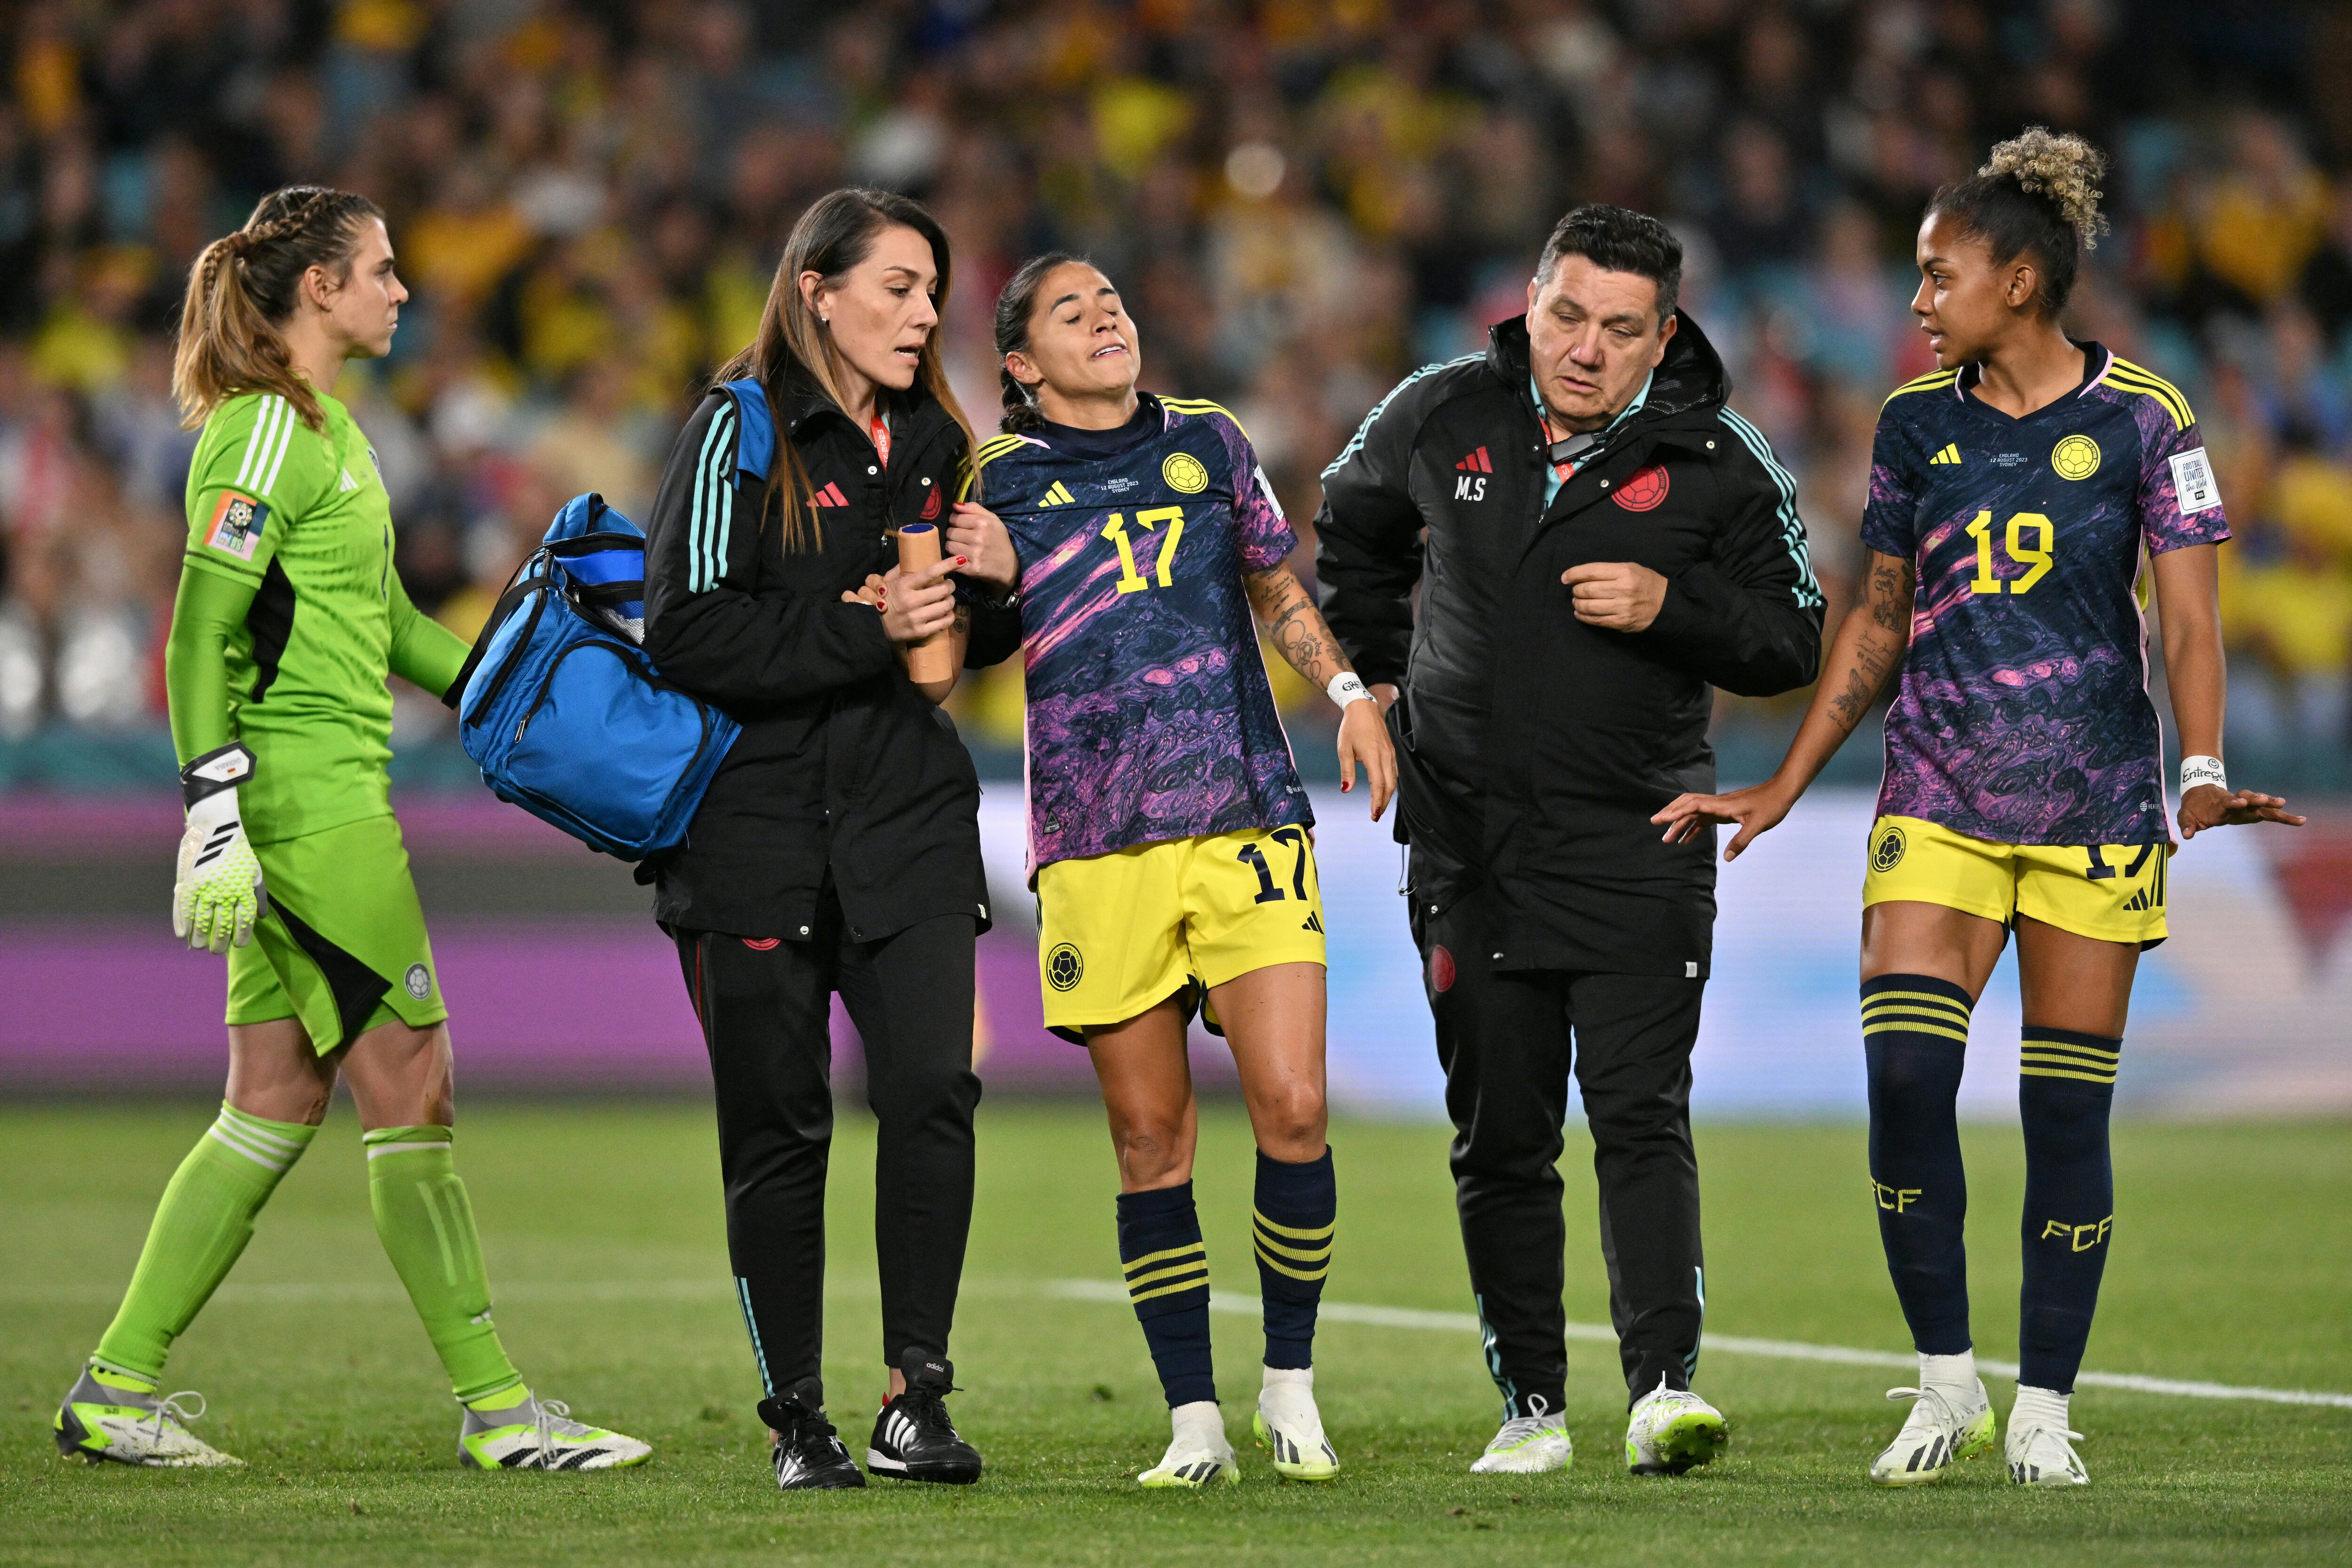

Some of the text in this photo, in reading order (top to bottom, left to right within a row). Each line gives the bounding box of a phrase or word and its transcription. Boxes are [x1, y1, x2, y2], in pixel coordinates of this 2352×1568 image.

[2183, 459, 2201, 471] FOOTBALL
[2184, 467, 2204, 482] UNITES
[1455, 476, 1486, 501] M.S
[2185, 482, 2195, 492] the
[1101, 506, 1184, 594] 17
[1965, 510, 2053, 594] 19
[2183, 766, 2225, 783] Entrega
[1237, 828, 1307, 905] 17
[2042, 1214, 2113, 1252] FCF
[927, 1362, 944, 1373] adidas
